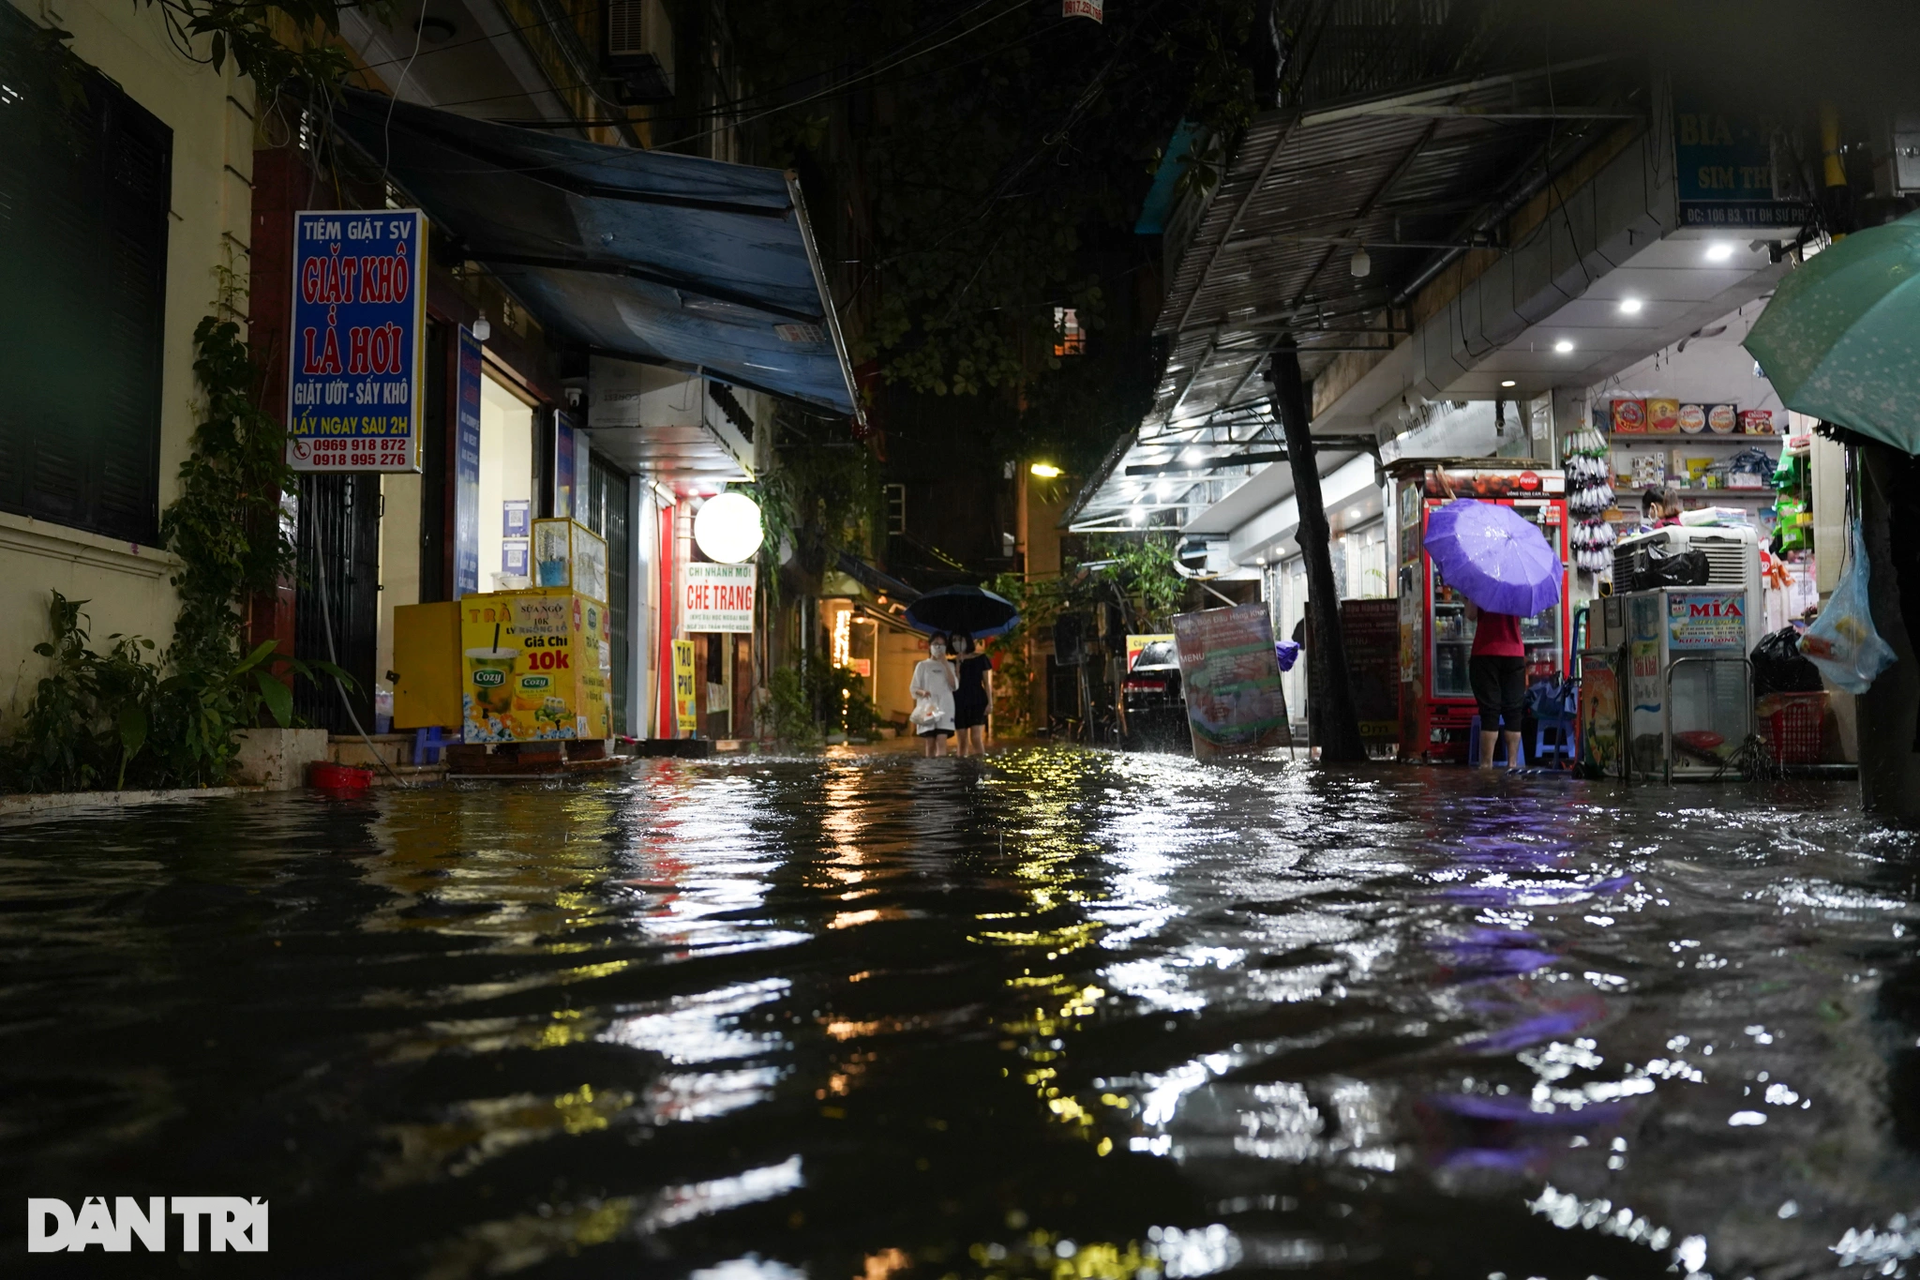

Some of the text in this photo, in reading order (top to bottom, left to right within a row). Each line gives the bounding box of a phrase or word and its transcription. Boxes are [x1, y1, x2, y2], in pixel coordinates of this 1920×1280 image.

[1678, 113, 1735, 146] BIA
[1698, 165, 1773, 189] SIM TH
[1747, 208, 1756, 222] TT
[304, 218, 411, 244] TIỆM GIẶT SV
[302, 241, 409, 312] GIẶT KHÔ
[303, 310, 403, 375] LÀ HƠI
[294, 378, 322, 409] GIẶT
[356, 375, 381, 405] SẤY
[383, 377, 408, 405] KHÔ
[293, 408, 408, 435] LẤY NGAY SAU 2H
[313, 438, 406, 451] 0969 918 872
[313, 453, 406, 466] 0918 995 276
[689, 566, 703, 577] CHI
[687, 579, 752, 611] CHÈ TRANG
[469, 603, 511, 623] TRÀ
[524, 636, 544, 647] Giá
[528, 650, 569, 670] 10k
[1180, 652, 1205, 663] MENU
[476, 672, 502, 683] Cozy
